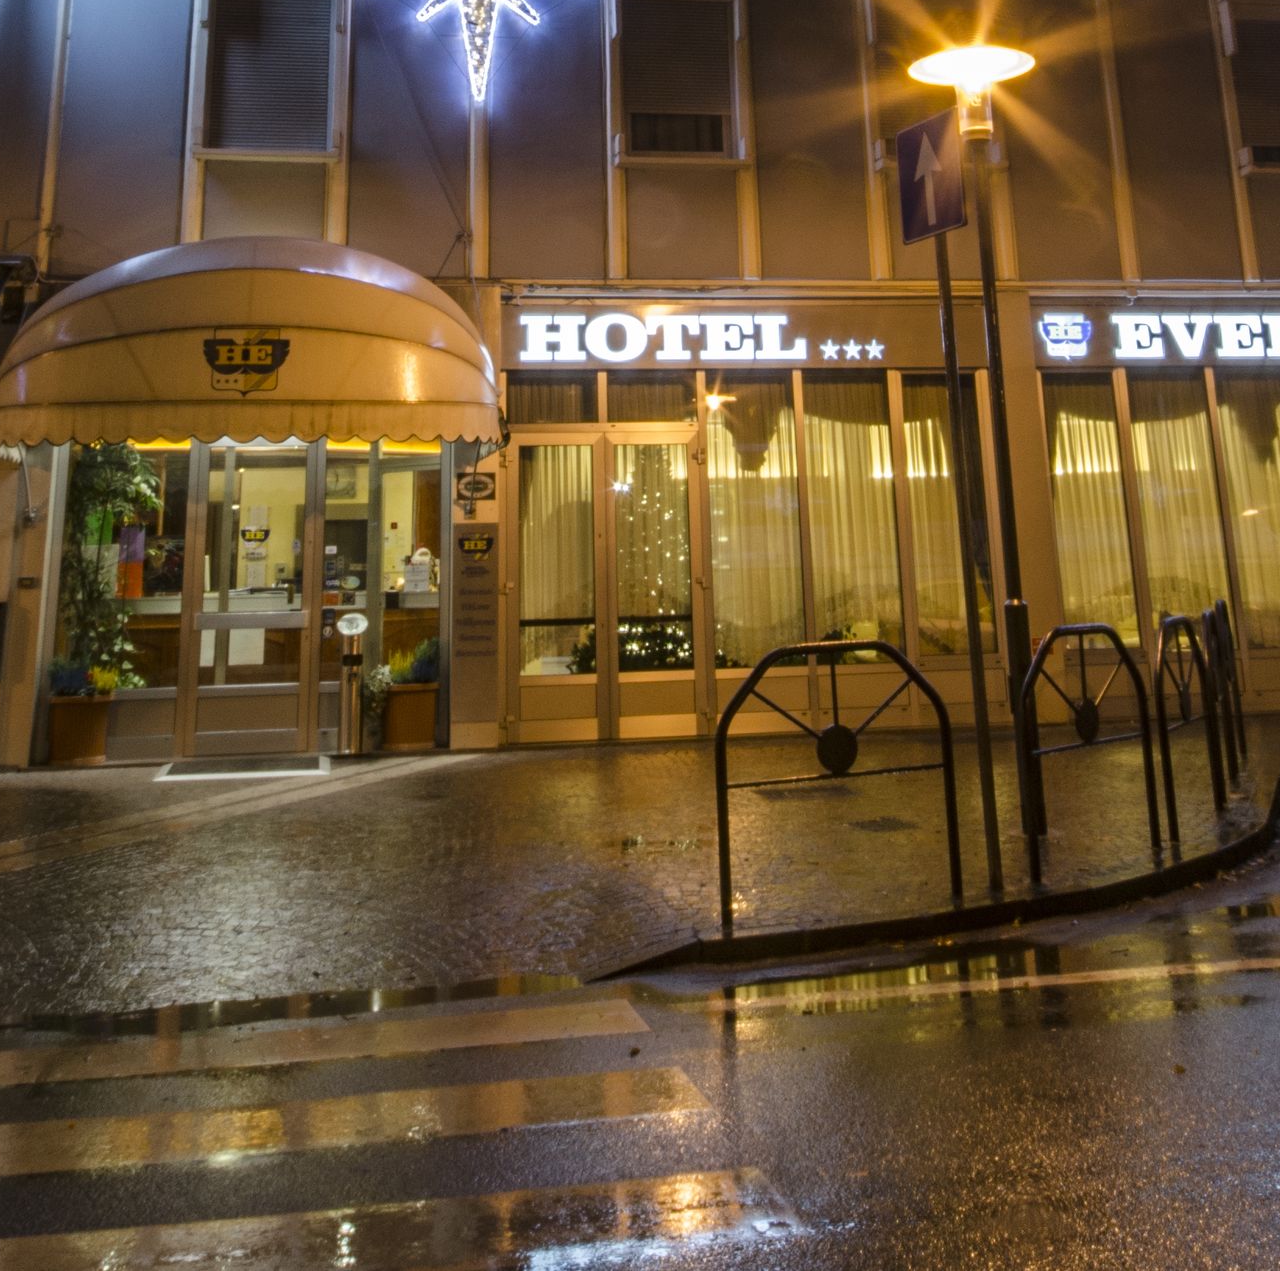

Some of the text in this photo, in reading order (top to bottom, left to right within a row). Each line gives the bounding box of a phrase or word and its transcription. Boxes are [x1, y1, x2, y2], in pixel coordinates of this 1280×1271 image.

[518, 313, 807, 363] HOTEL
[215, 344, 274, 365] HE
[463, 540, 488, 550] HE
